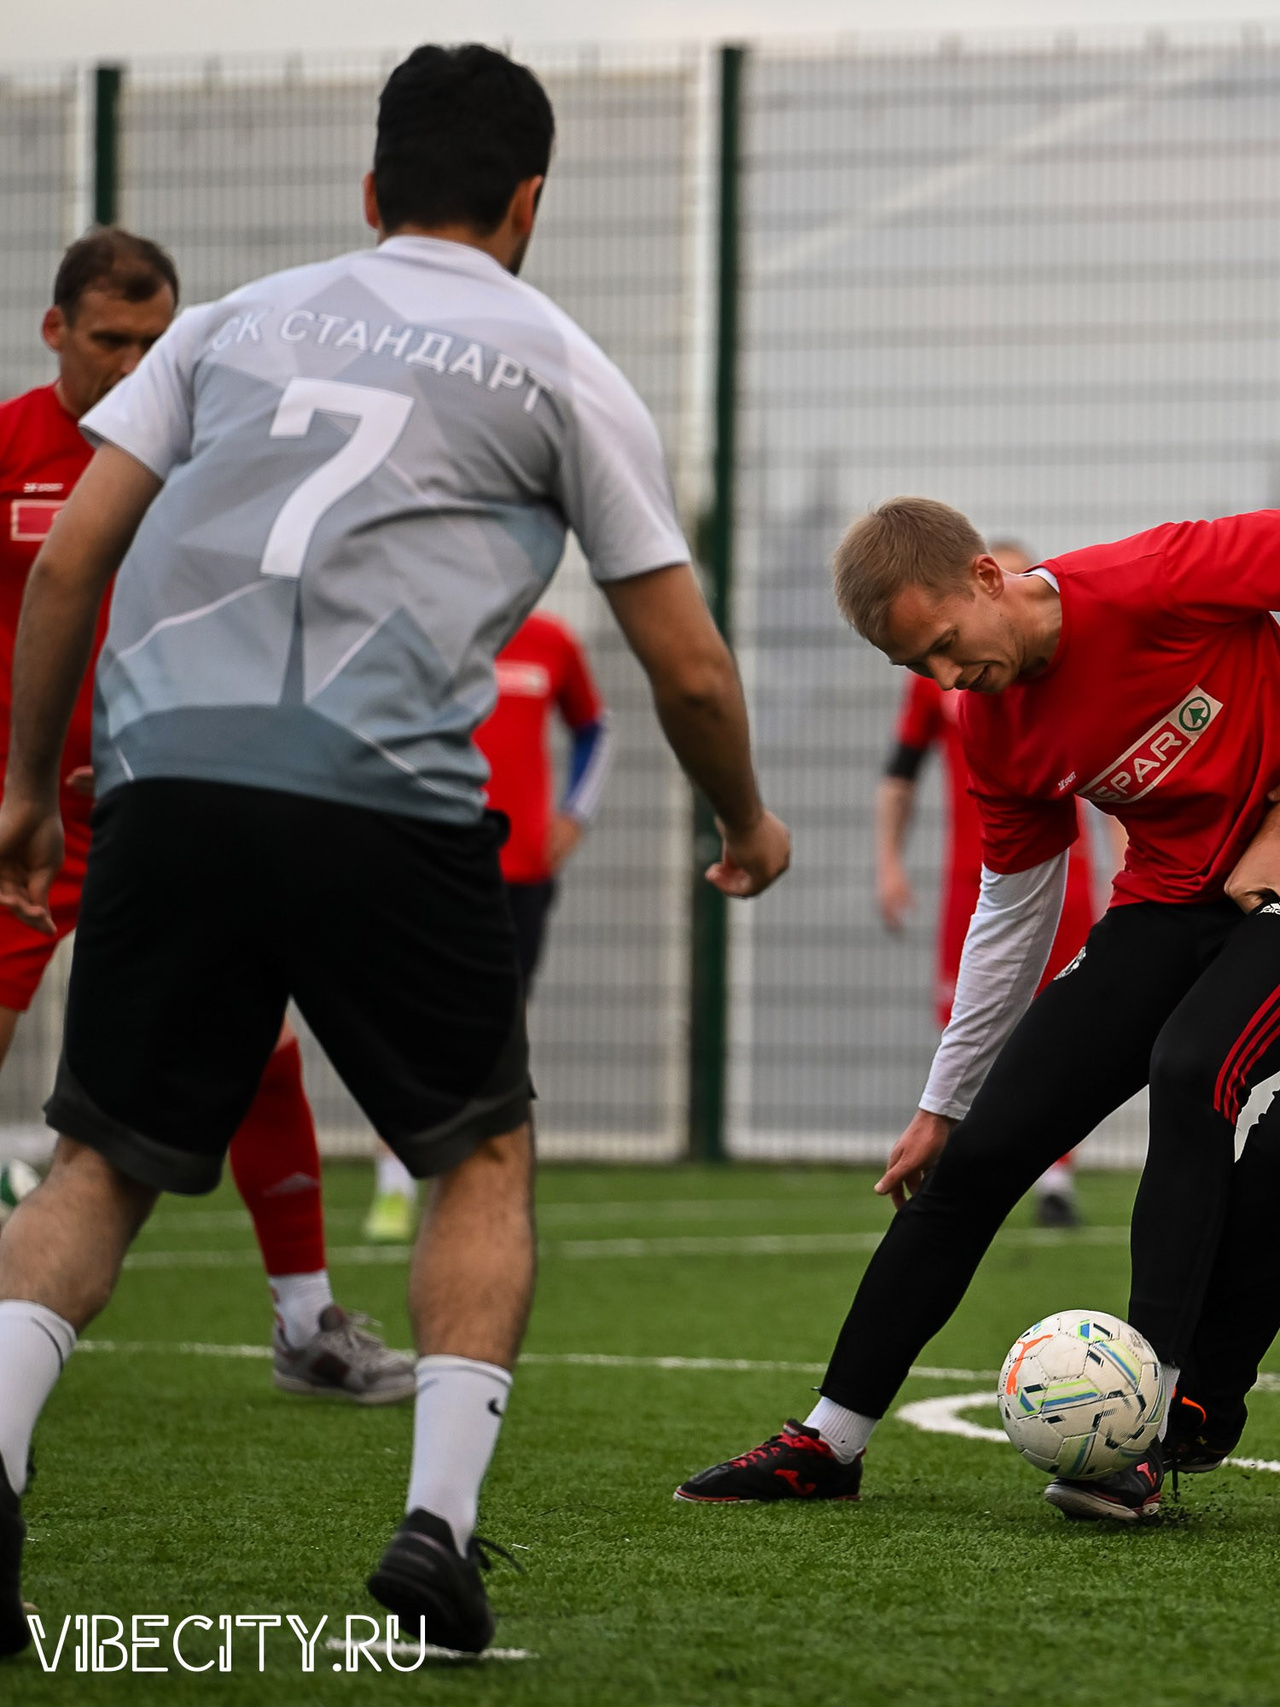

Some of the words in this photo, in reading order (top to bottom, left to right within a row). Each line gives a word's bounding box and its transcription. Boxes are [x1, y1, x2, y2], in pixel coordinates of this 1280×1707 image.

[212, 308, 272, 352] СК
[279, 309, 554, 414] СТАНДАРТ
[260, 376, 415, 578] 7
[1094, 731, 1183, 801] SPAR
